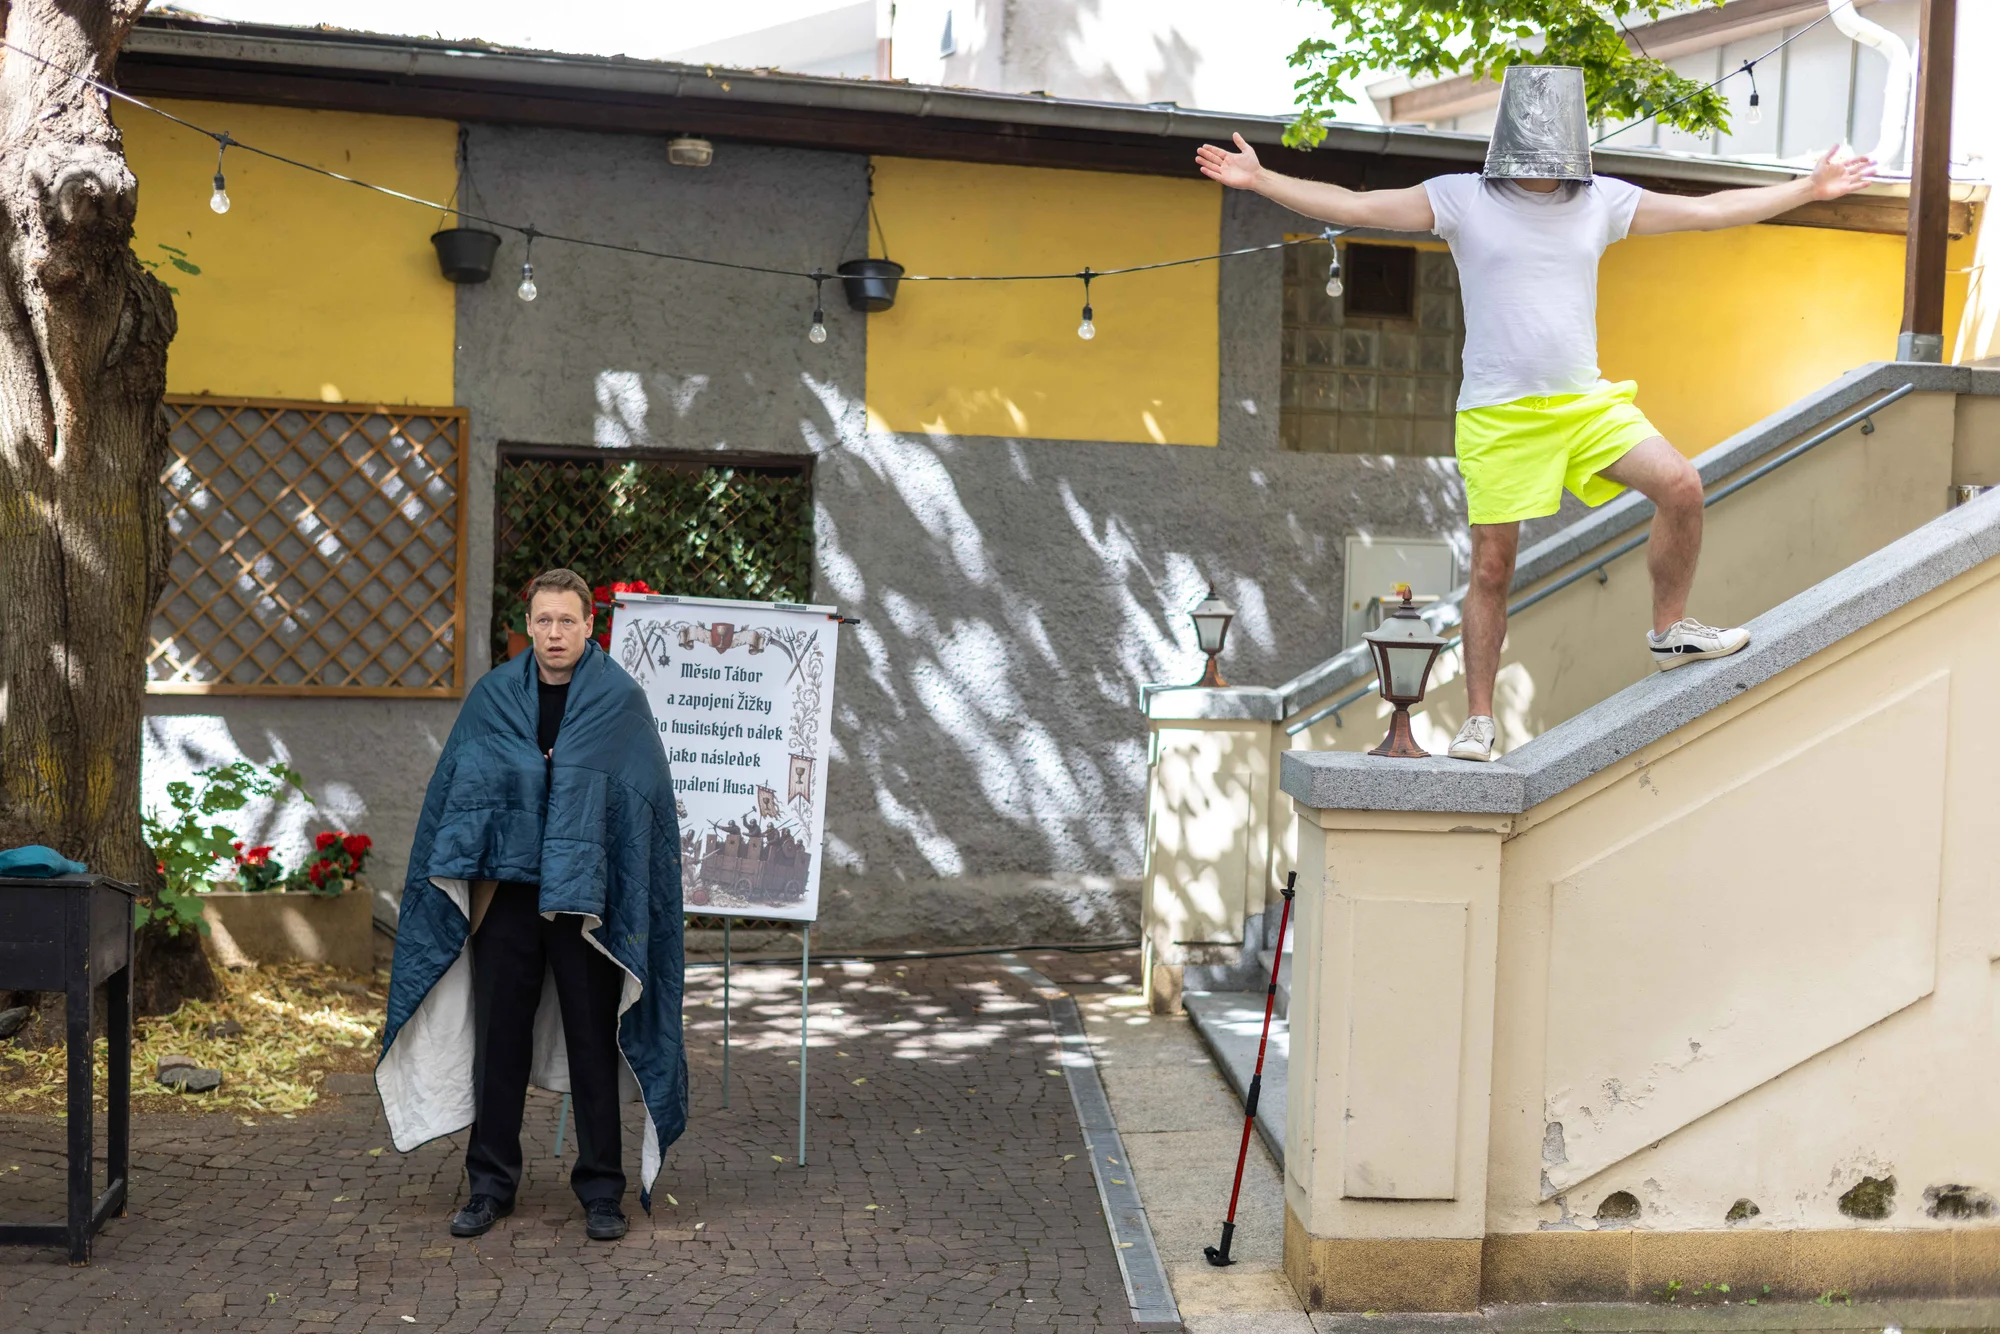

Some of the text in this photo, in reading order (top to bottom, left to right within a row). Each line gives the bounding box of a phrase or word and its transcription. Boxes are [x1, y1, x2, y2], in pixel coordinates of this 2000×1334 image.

[681, 663, 763, 683] Město Tábor
[667, 691, 772, 715] a zapojení Žižky
[671, 719, 743, 740] husitských
[747, 724, 783, 741] válek
[668, 746, 761, 767] jako následek
[723, 778, 755, 795] Husa
